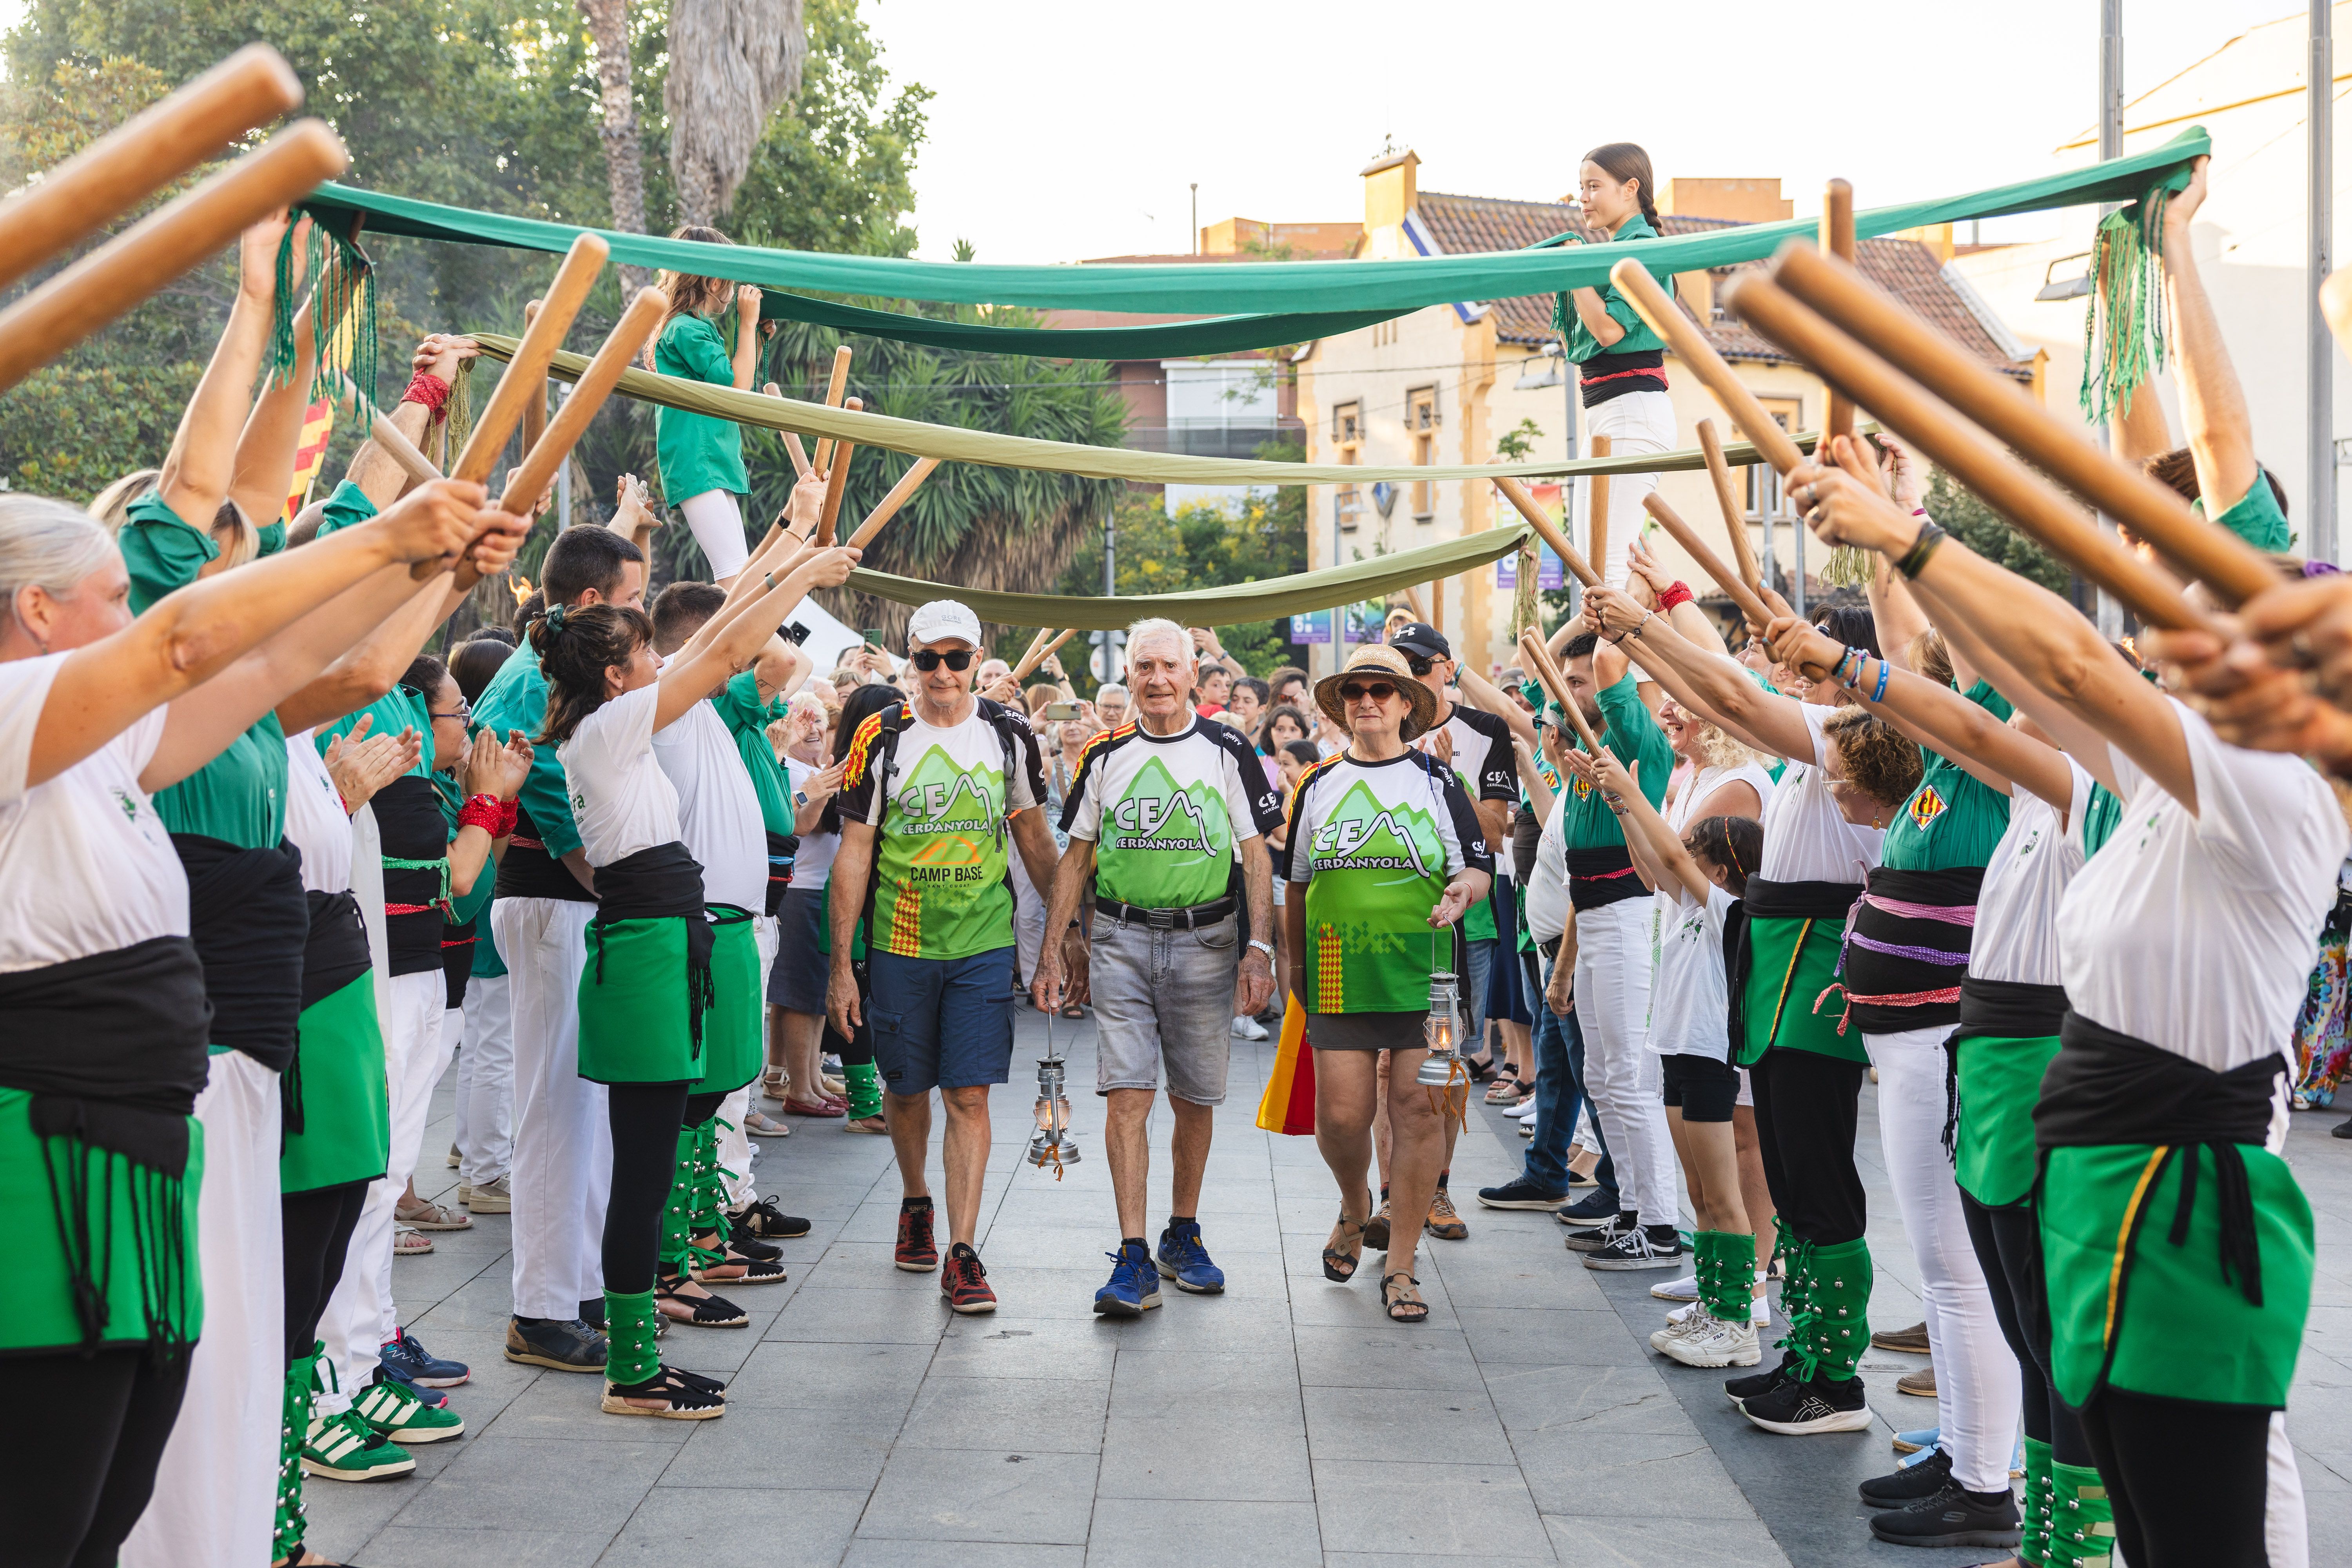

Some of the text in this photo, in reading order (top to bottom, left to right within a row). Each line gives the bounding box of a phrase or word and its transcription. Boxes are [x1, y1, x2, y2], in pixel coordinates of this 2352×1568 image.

[1005, 710, 1034, 736] SPORTY
[1486, 770, 1515, 793] CEM
[898, 772, 993, 837] CEM
[902, 819, 989, 835] CERDANYOLA
[1114, 789, 1218, 857] CEM
[1116, 837, 1203, 851] CERDANYOLA
[1315, 810, 1430, 878] CEM
[911, 866, 983, 882] CAMP BASE
[1313, 856, 1416, 871] CERDANYOLA
